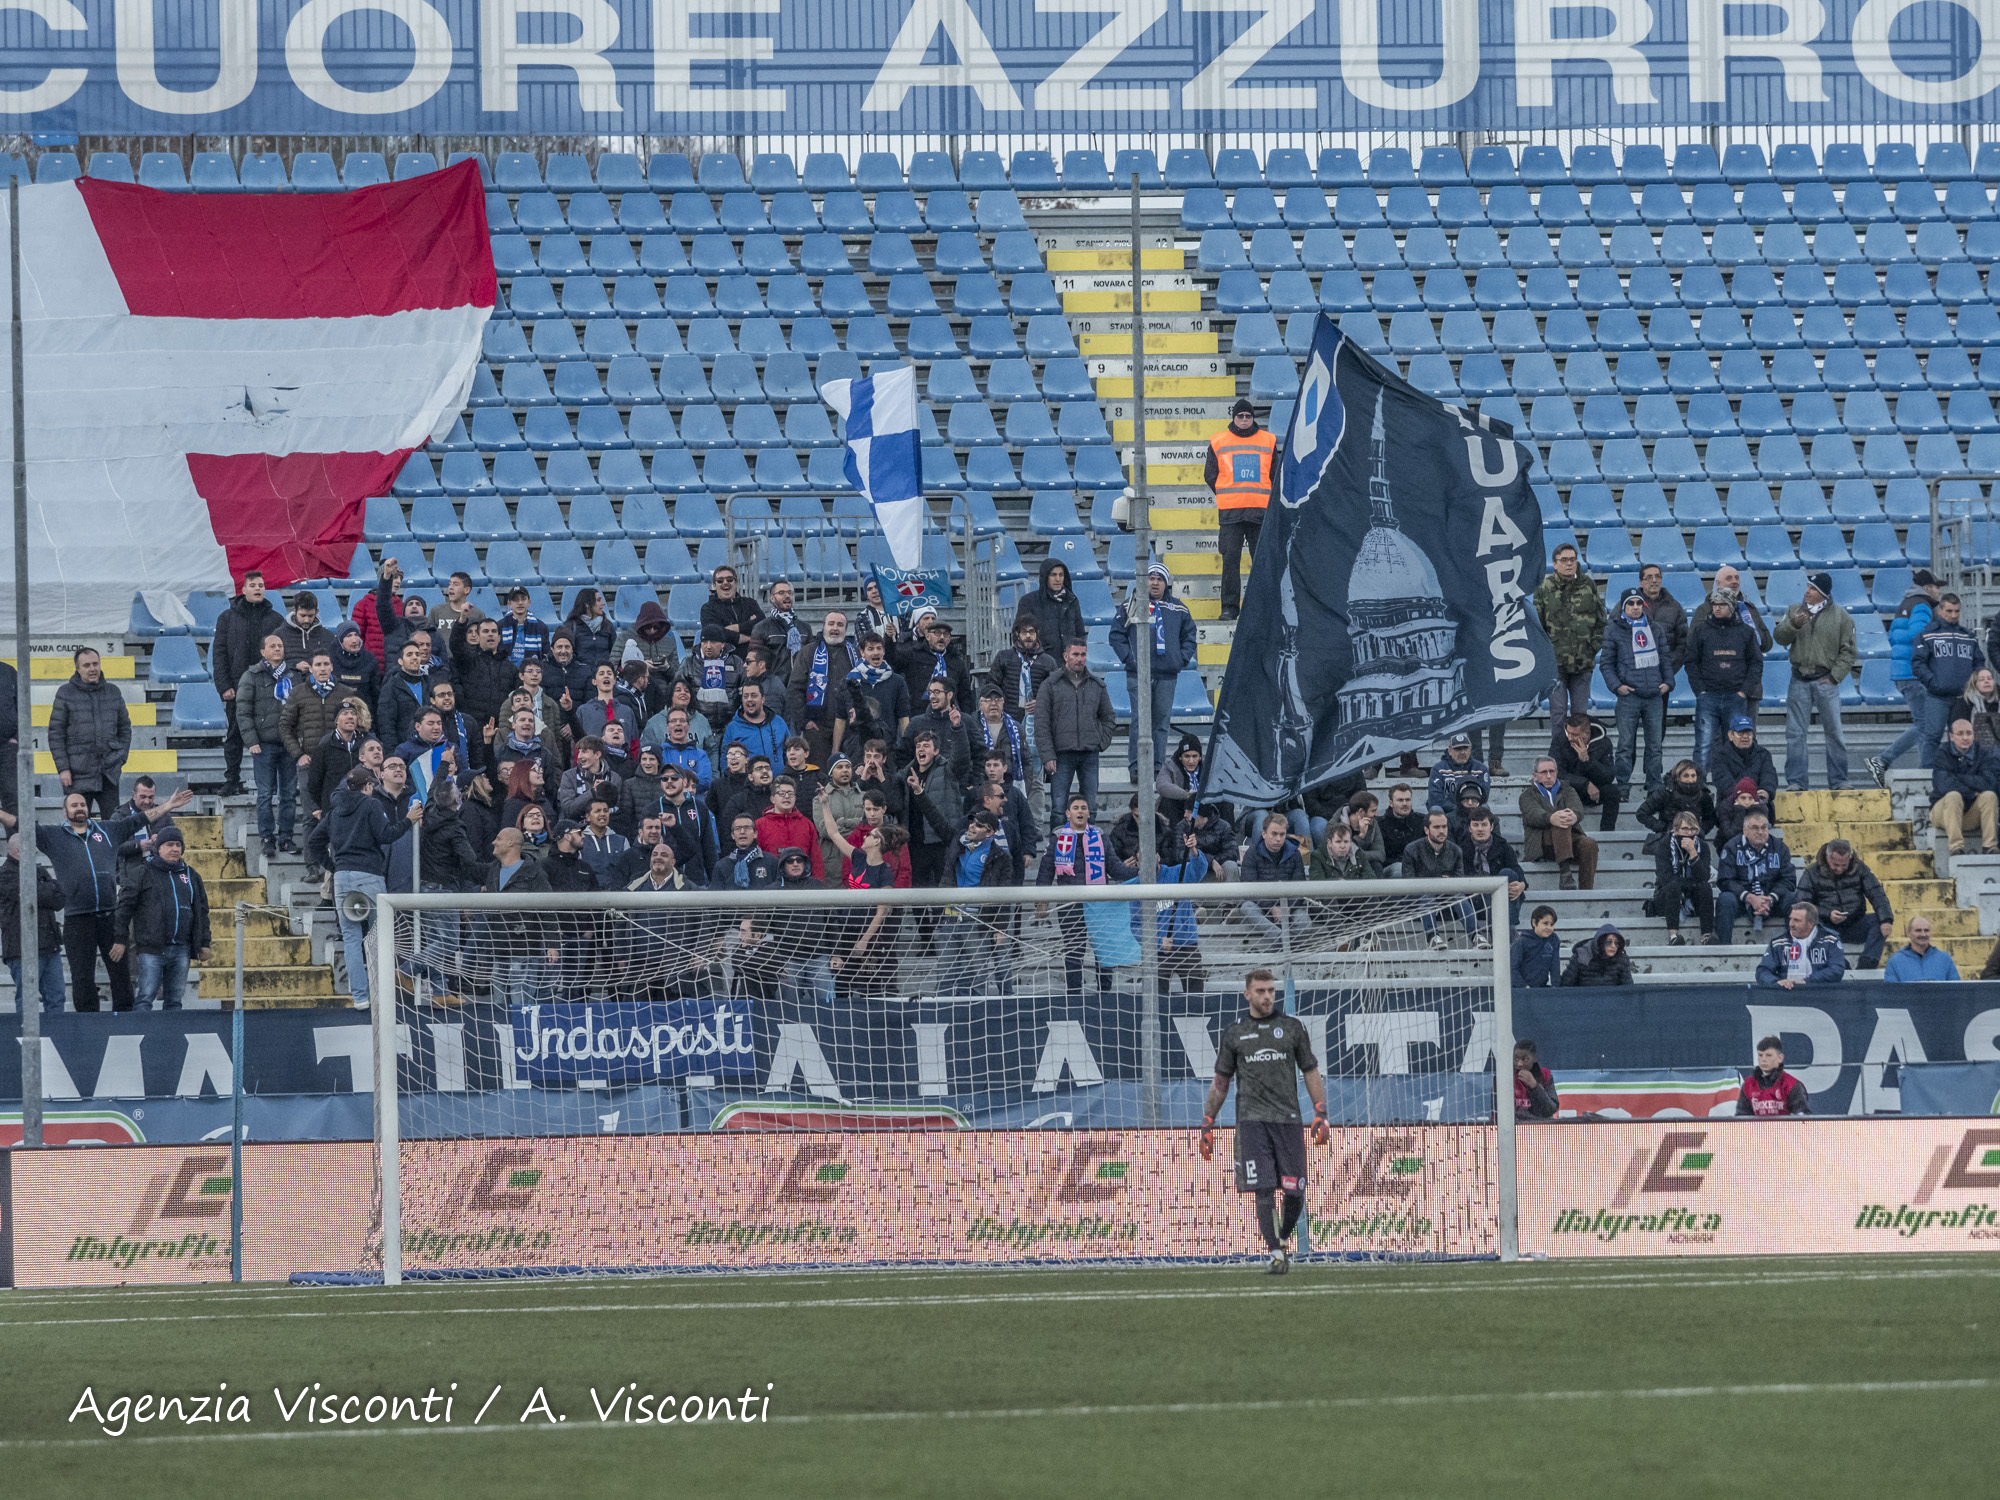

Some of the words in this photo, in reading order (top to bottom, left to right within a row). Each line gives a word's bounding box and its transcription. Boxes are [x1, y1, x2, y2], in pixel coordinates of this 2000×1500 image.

[0, 0, 787, 115] CUORE
[861, 0, 2000, 111] AZZURRO
[1045, 239, 1057, 249] 12
[1114, 240, 1133, 248] PIOL
[1156, 238, 1168, 248] 12
[1063, 279, 1075, 290] 11
[1093, 280, 1126, 288] NOVARA
[1127, 280, 1155, 288] CCIO
[1174, 278, 1186, 288] 11
[1079, 321, 1091, 332] 10
[1149, 322, 1171, 330] PIOLA
[1190, 320, 1202, 331] 10
[1097, 363, 1105, 374] 9
[1126, 364, 1159, 372] NARA
[1161, 364, 1189, 372] CALCIO
[1209, 363, 1218, 373] 9
[1115, 406, 1123, 417] 8
[1144, 407, 1172, 416] STADIO
[1174, 407, 1182, 415] S.
[1183, 407, 1206, 415] PIOLA
[1161, 451, 1194, 460] NOVARA
[1240, 468, 1255, 479] 074
[1177, 497, 1206, 505] STADIO
[1166, 540, 1174, 551] 5
[1195, 541, 1219, 549] NOVA
[1182, 584, 1190, 595] 4
[896, 595, 940, 613] 1908
[1198, 630, 1206, 640] 3
[29, 644, 55, 653] OVARA
[106, 642, 115, 653] 3
[1217, 675, 1225, 685] 2
[31, 738, 39, 749] 1
[150, 736, 158, 747] 1
[1244, 1053, 1271, 1063] BANCO
[1272, 1052, 1287, 1062] BPM
[1245, 1159, 1258, 1179] 12
[1855, 1203, 2000, 1238] italgrafic
